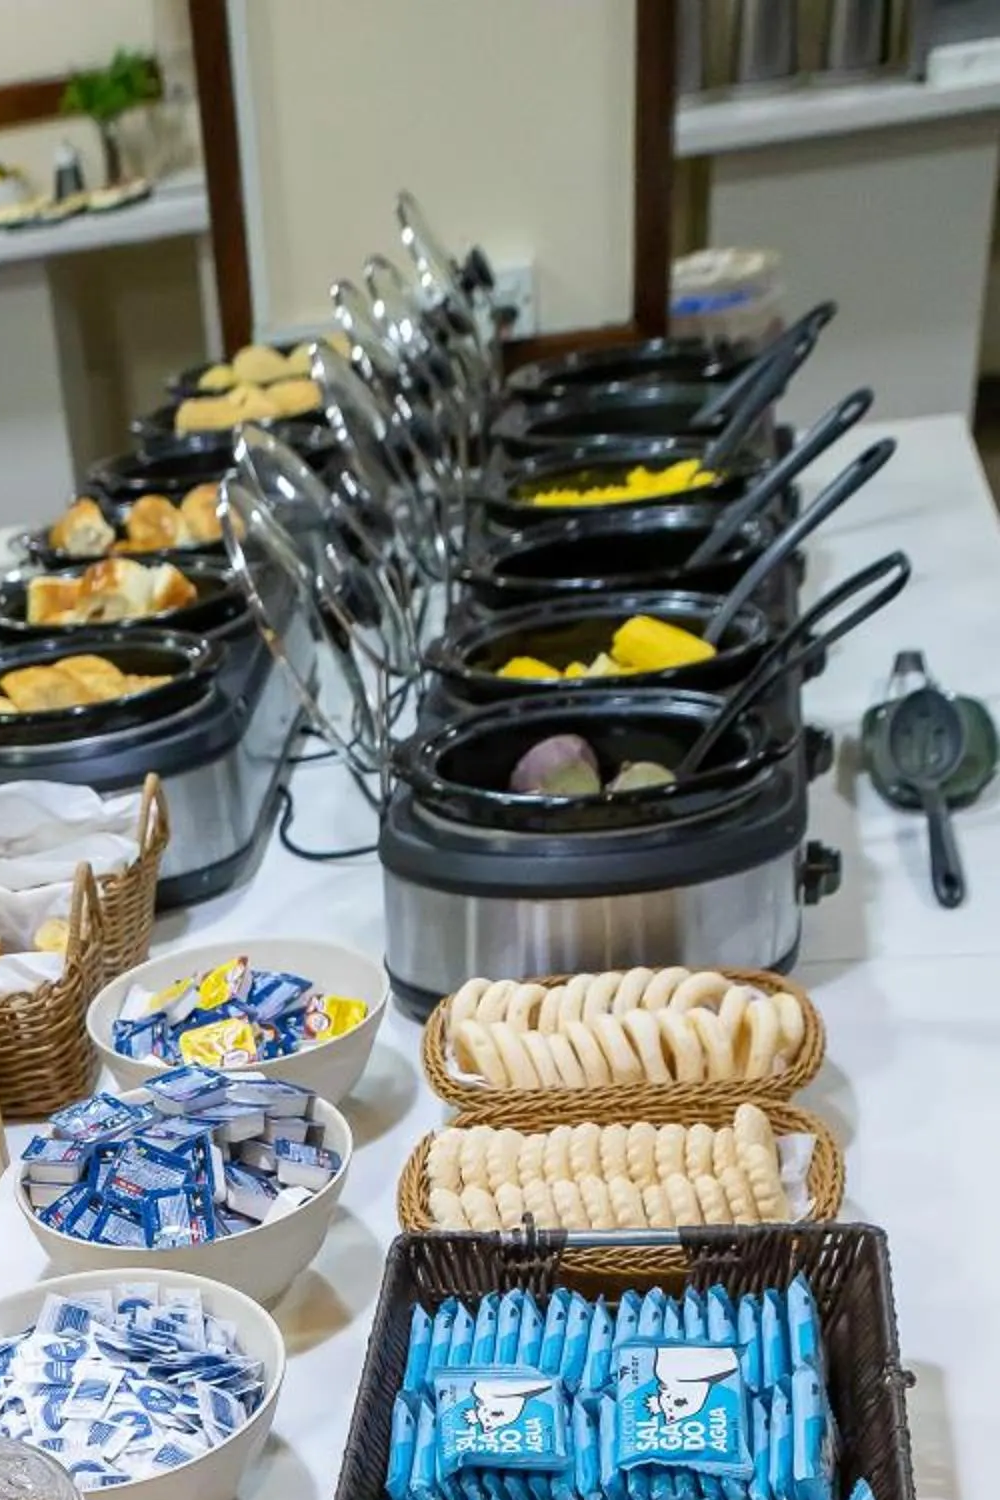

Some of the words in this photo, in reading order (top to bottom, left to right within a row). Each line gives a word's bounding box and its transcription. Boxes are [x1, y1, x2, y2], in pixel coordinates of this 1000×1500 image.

[499, 1429, 522, 1453] DO
[636, 1416, 659, 1452] SAL
[660, 1422, 683, 1451] GA
[683, 1421, 706, 1452] DO
